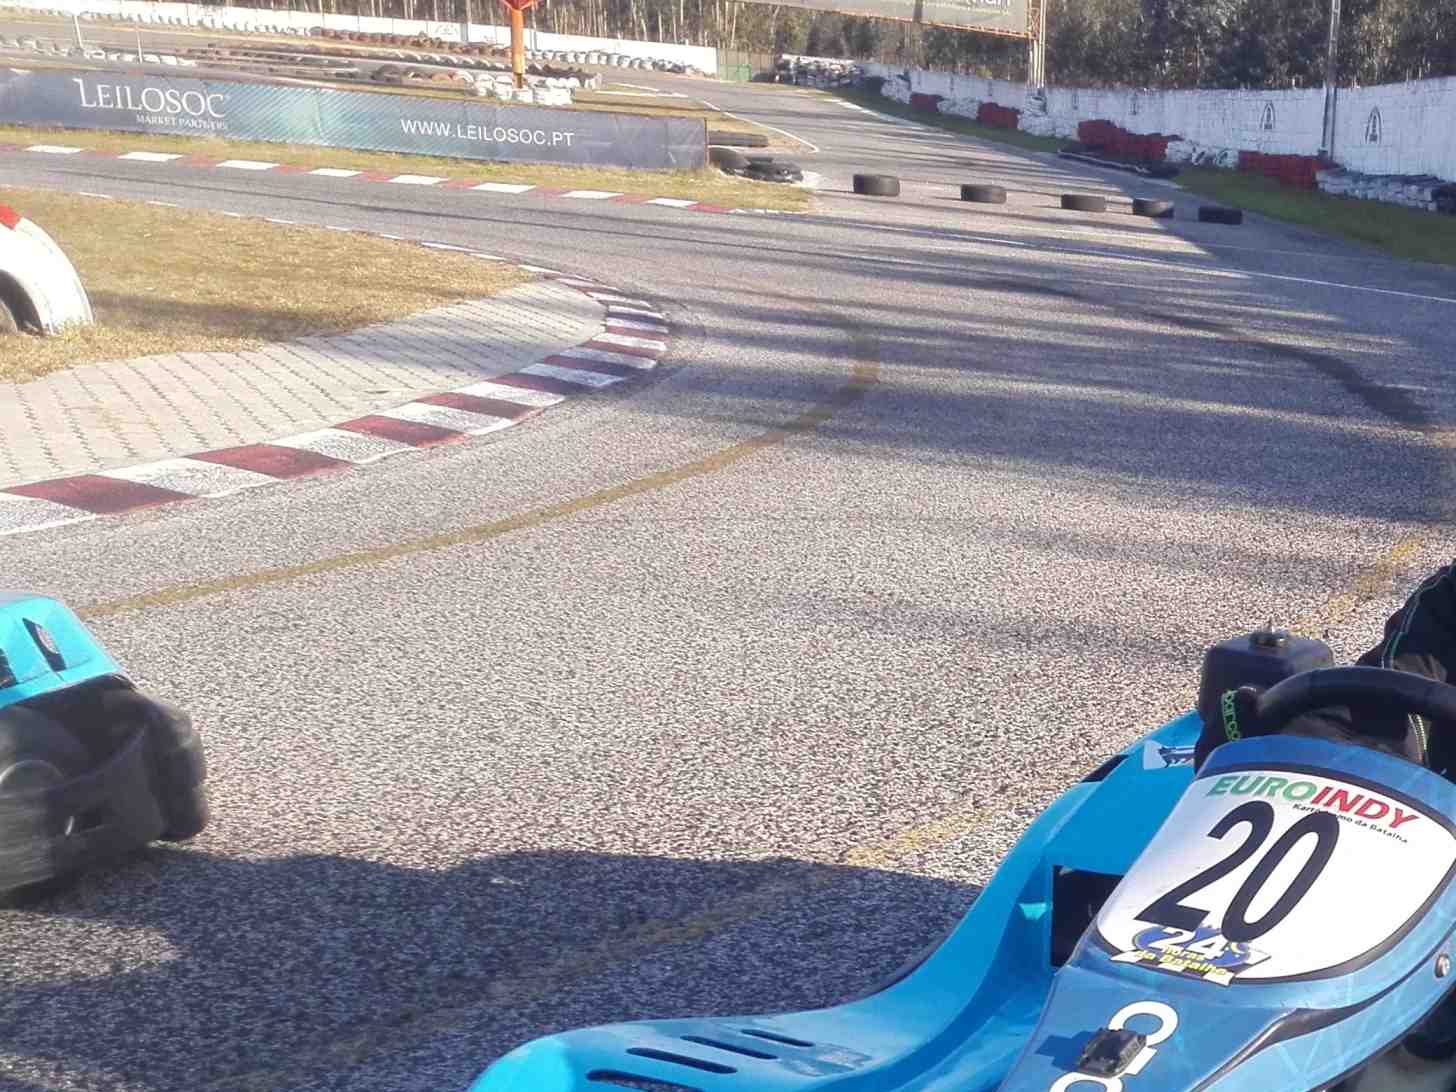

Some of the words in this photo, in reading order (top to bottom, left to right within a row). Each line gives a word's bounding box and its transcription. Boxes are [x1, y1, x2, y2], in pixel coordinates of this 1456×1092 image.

[72, 78, 225, 118] LEILOSOC
[136, 114, 177, 127] MARKET
[400, 118, 575, 147] WWW.LEILOSOC.PT
[1206, 774, 1420, 829] EUROINDY
[1133, 799, 1340, 943] 20
[1148, 926, 1229, 960] 24
